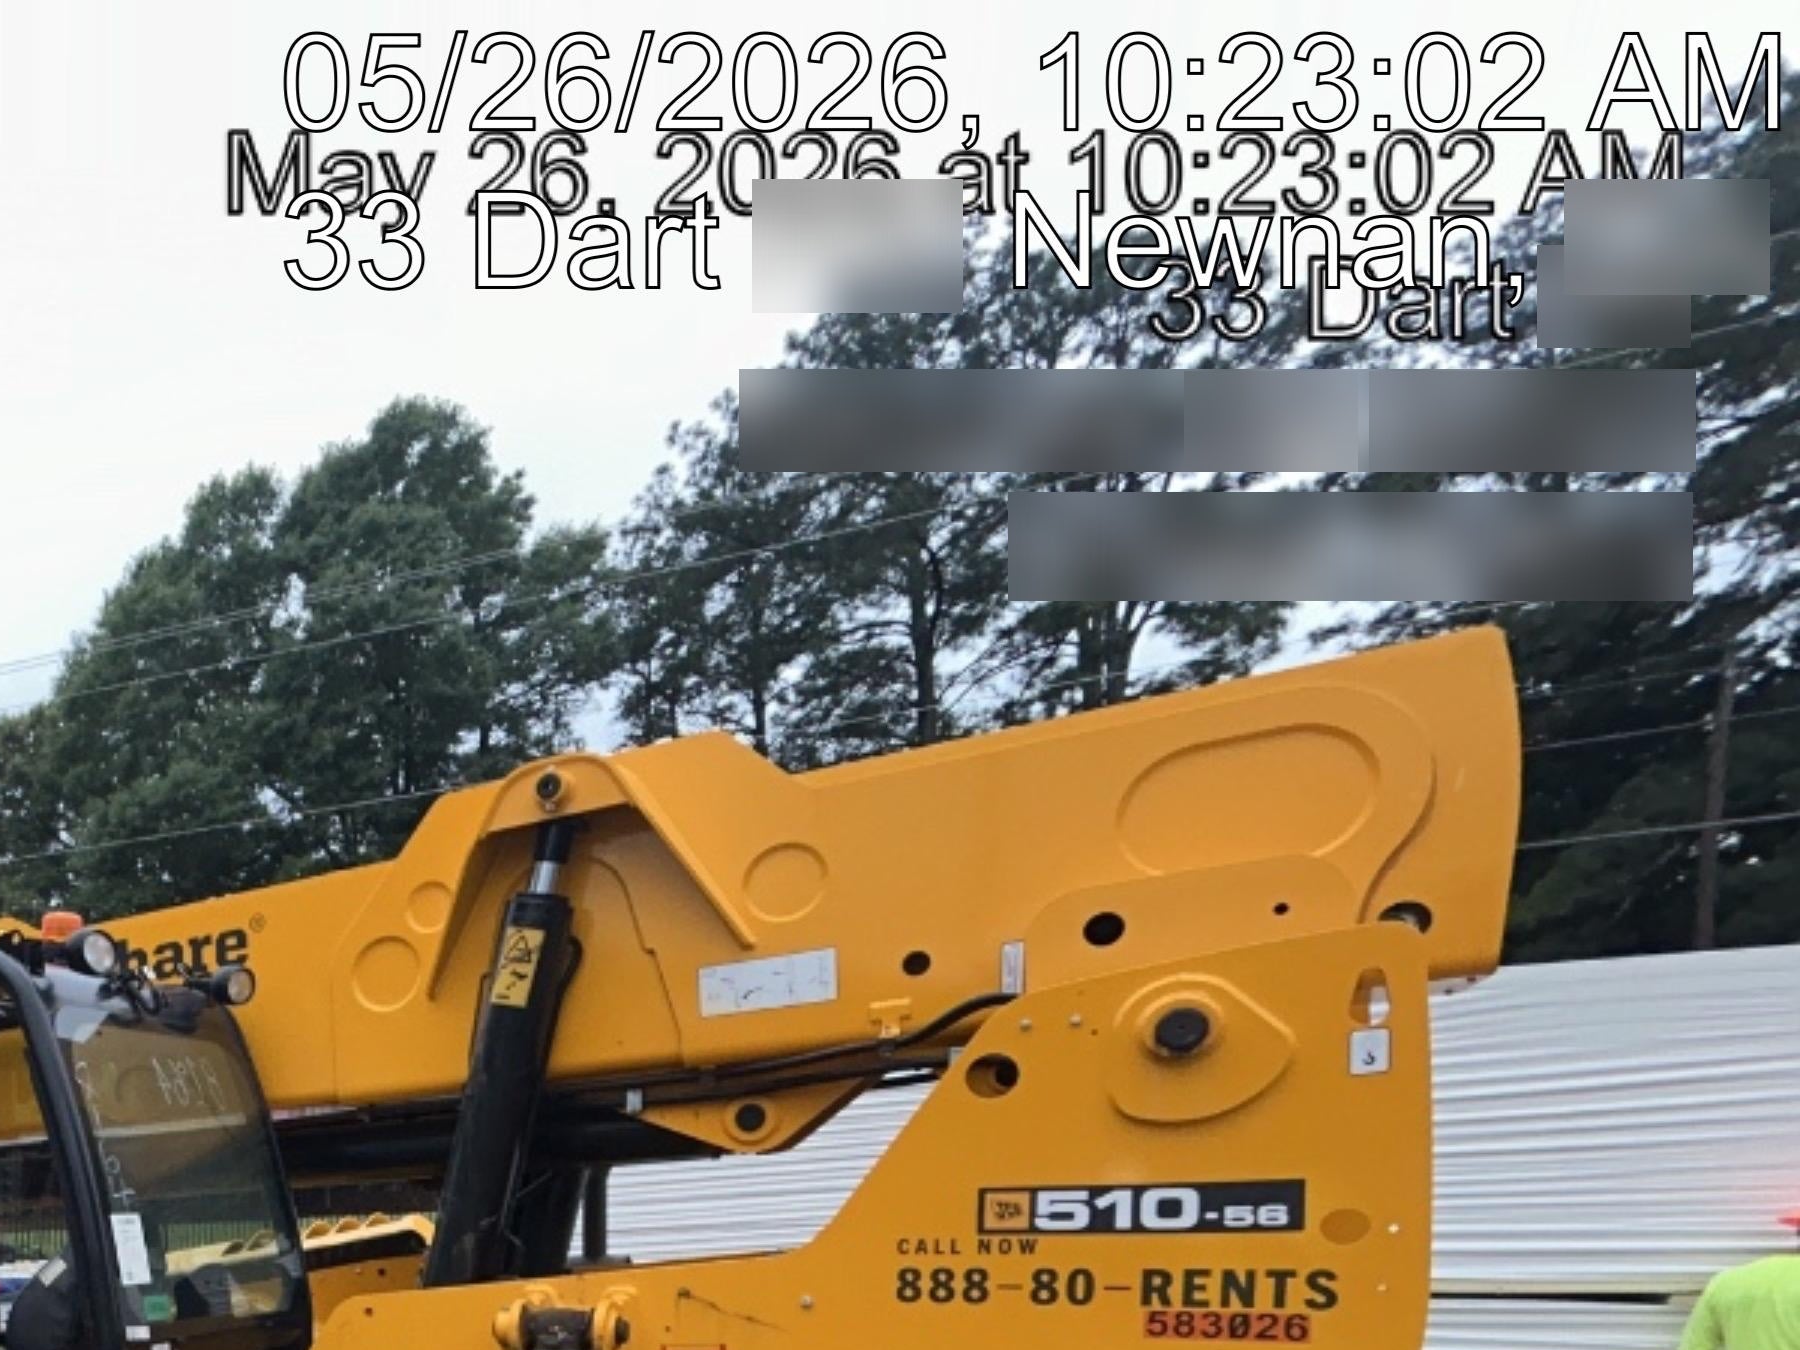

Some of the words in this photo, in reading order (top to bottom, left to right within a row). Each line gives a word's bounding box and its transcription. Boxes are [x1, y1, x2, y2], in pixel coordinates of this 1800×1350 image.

[1033, 1186, 1290, 1232] 510-56
[896, 1238, 962, 1255] CALL
[977, 1237, 1039, 1255] NOW
[896, 1266, 1340, 1312] 888-80-RENTS
[1145, 1309, 1310, 1343] 583026
